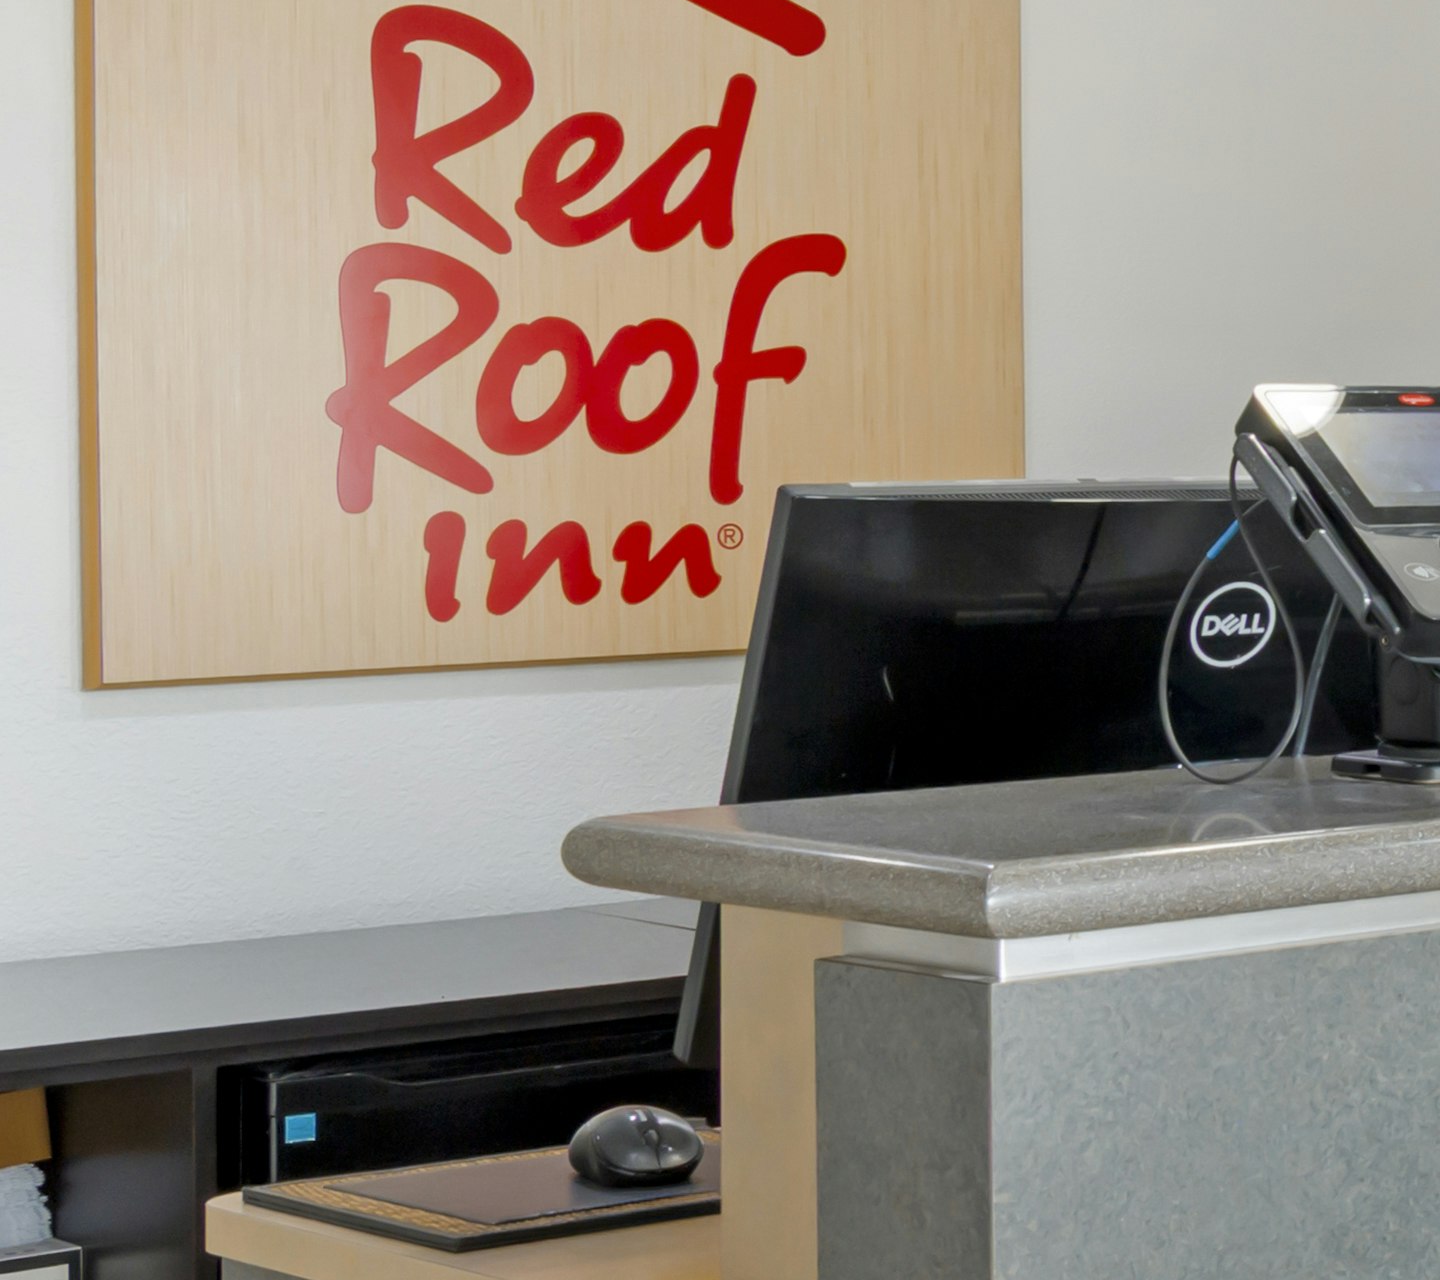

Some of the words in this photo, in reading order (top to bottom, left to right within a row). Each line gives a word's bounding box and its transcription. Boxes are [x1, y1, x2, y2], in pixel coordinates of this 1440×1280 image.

[369, 3, 757, 254] Red
[325, 233, 847, 514] Roof
[1201, 612, 1265, 637] DELL
